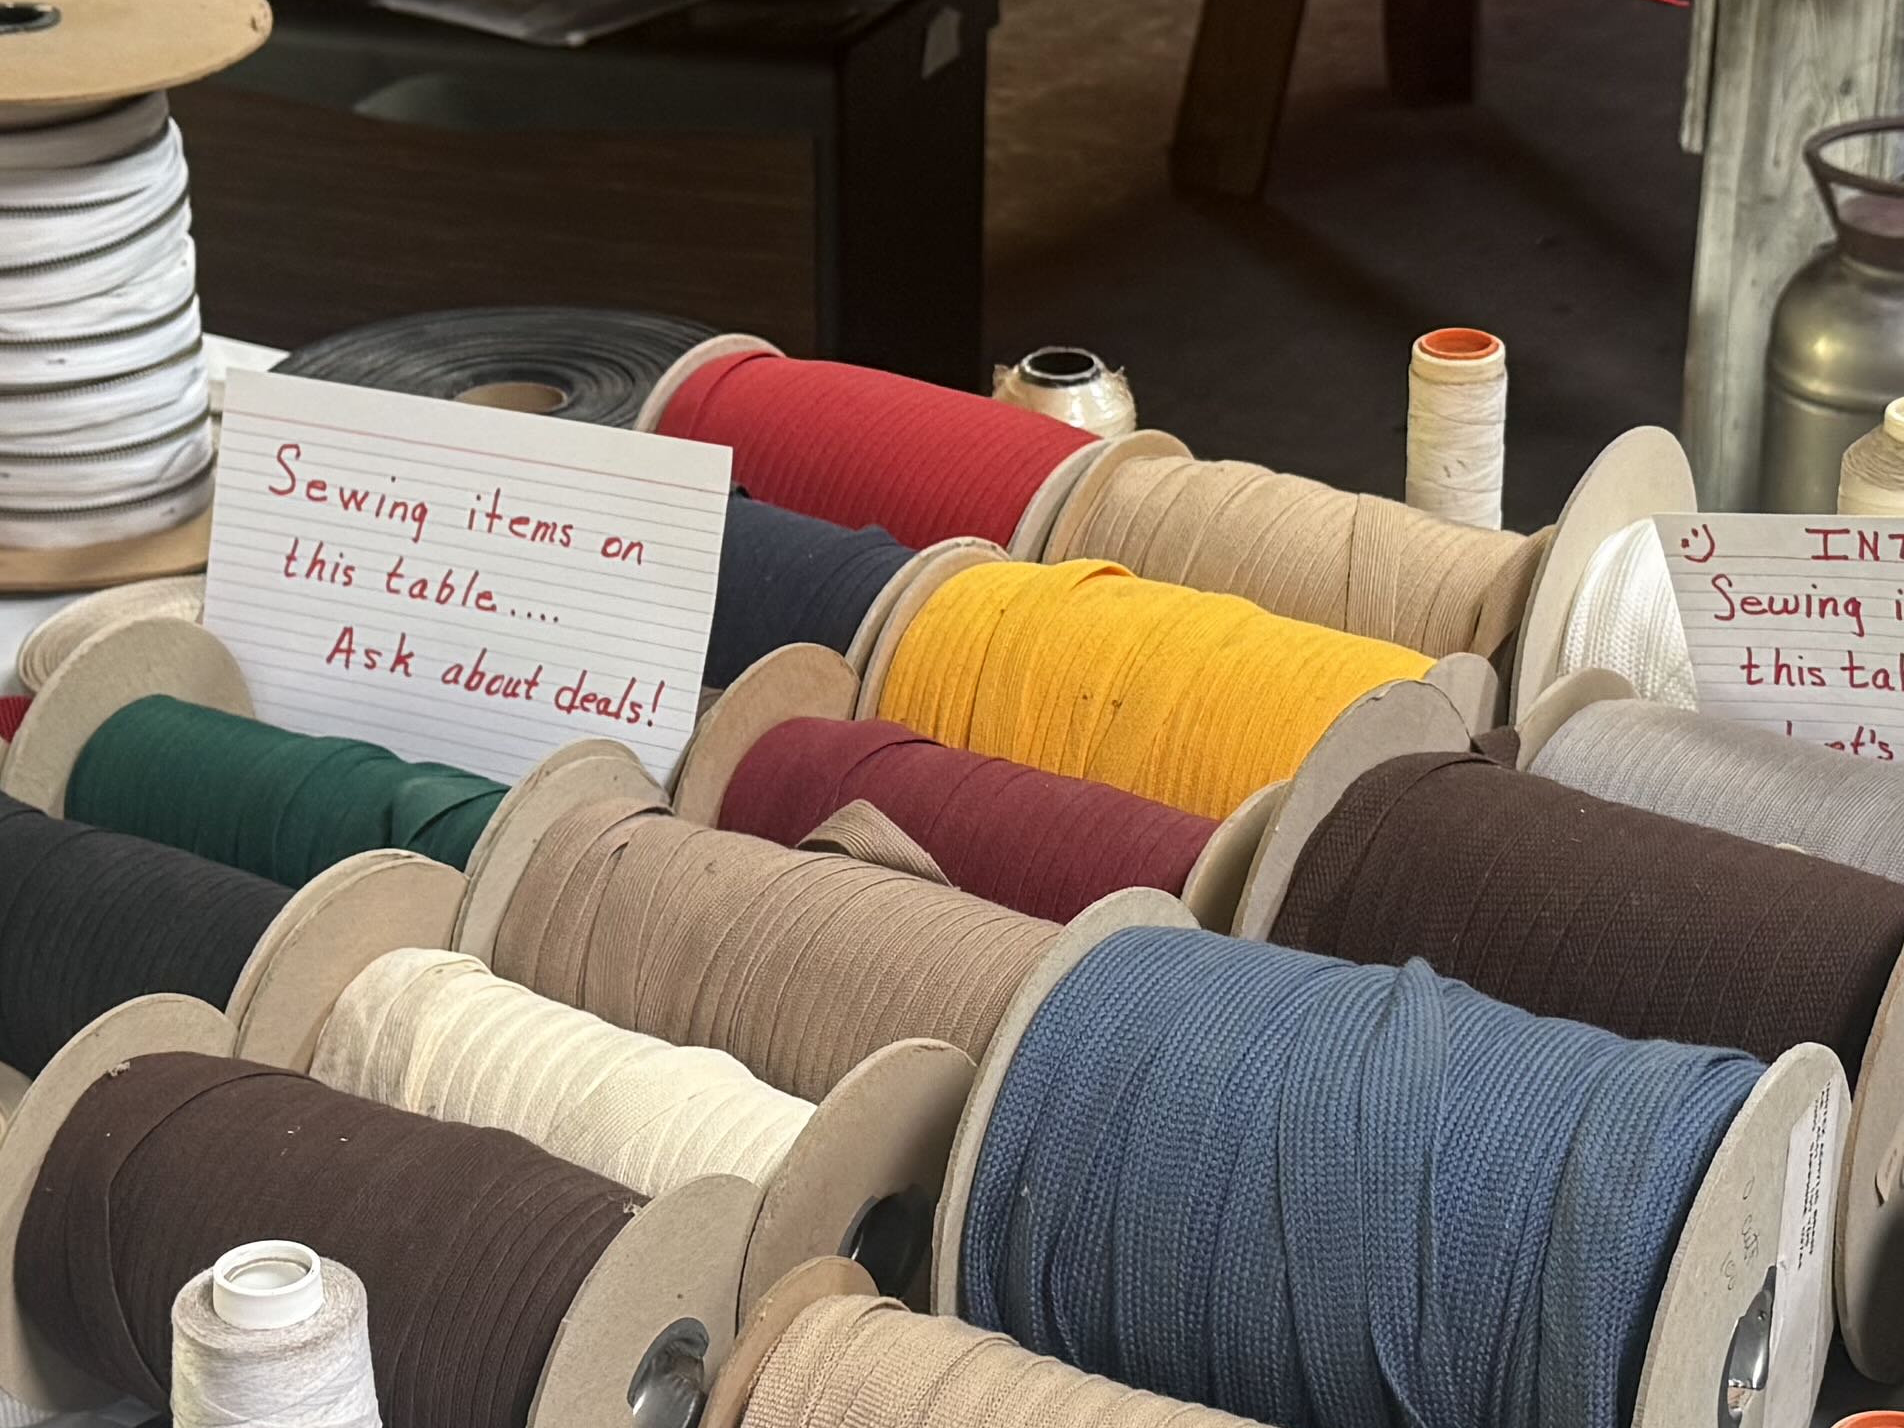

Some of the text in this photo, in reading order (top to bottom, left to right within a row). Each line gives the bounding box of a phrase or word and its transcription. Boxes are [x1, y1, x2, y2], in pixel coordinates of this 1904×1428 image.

[267, 443, 645, 566] Sewing items on
[282, 536, 356, 588] this
[1711, 574, 1865, 638] Sewing
[325, 625, 666, 728] Ask about deals!
[1740, 646, 1827, 690] this
